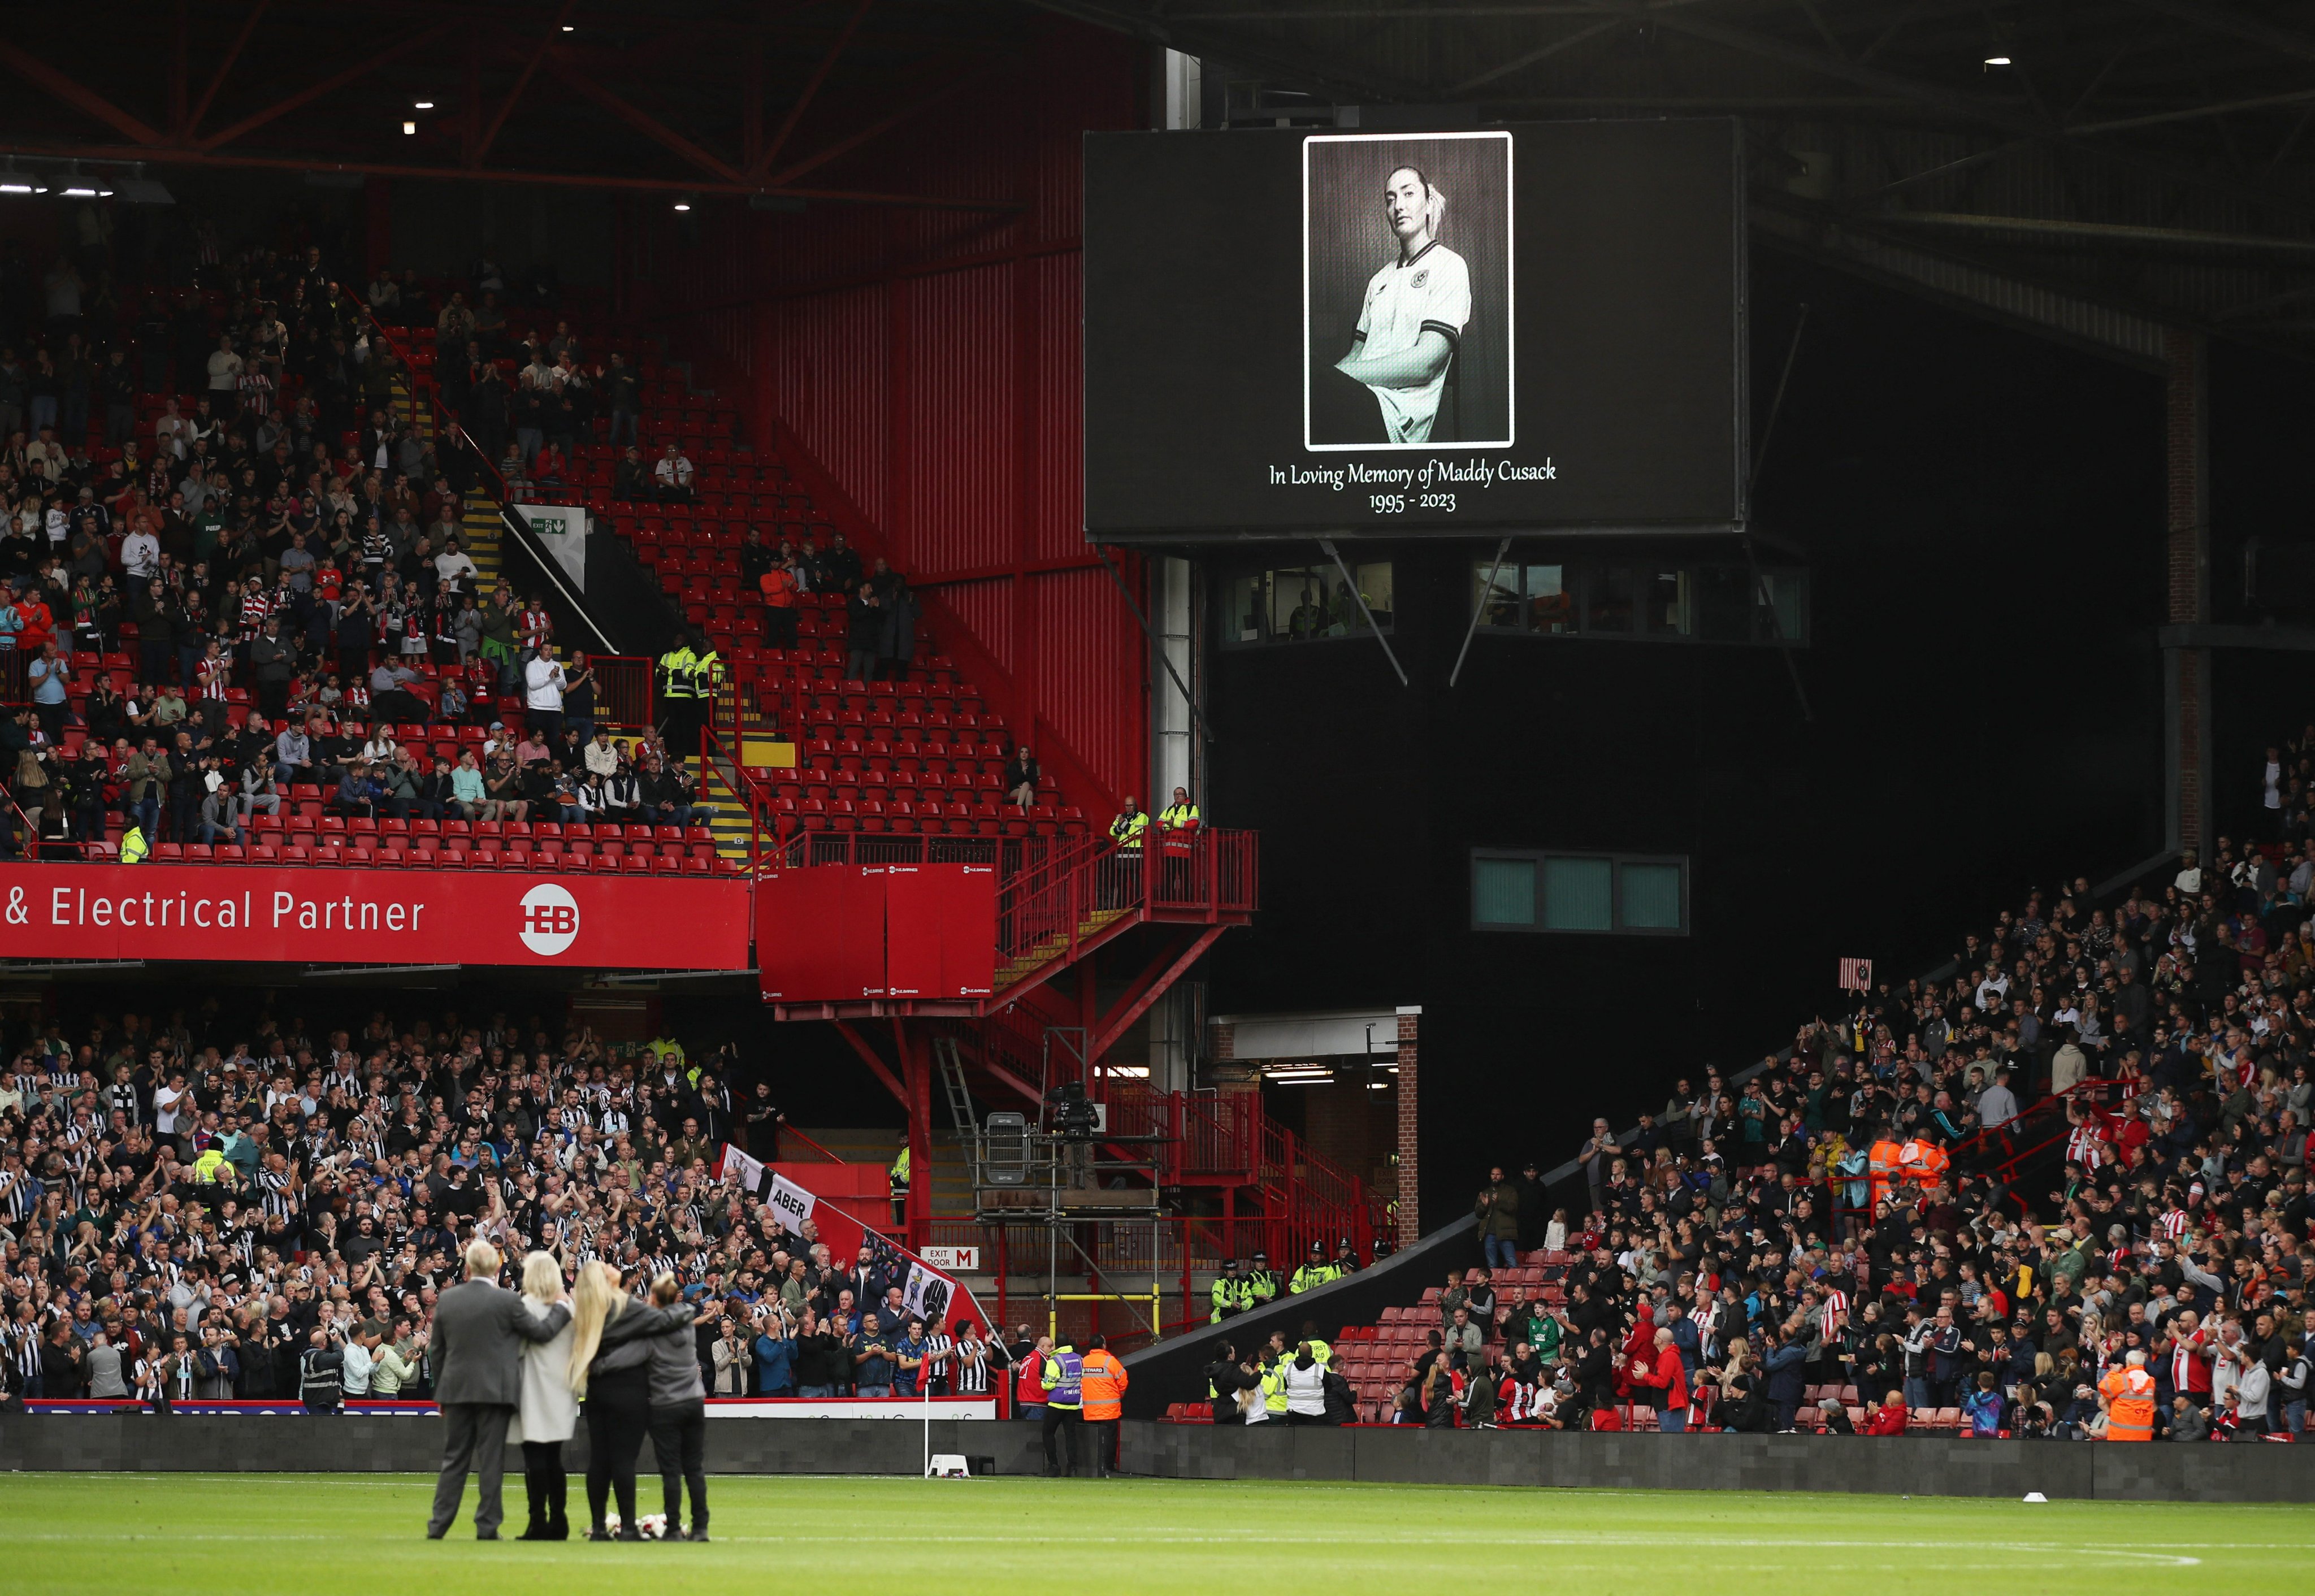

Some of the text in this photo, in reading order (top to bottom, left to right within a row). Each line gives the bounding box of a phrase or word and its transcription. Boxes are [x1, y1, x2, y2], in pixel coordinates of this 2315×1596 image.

[1269, 457, 1557, 491] In Loving Memory of Maddy Cusack
[1369, 494, 1405, 513] 1995
[1419, 493, 1456, 513] 2023
[5, 886, 424, 931] & Electrical Partner
[519, 905, 576, 934] HEB
[773, 1189, 805, 1219] ABER
[956, 1250, 971, 1267] M
